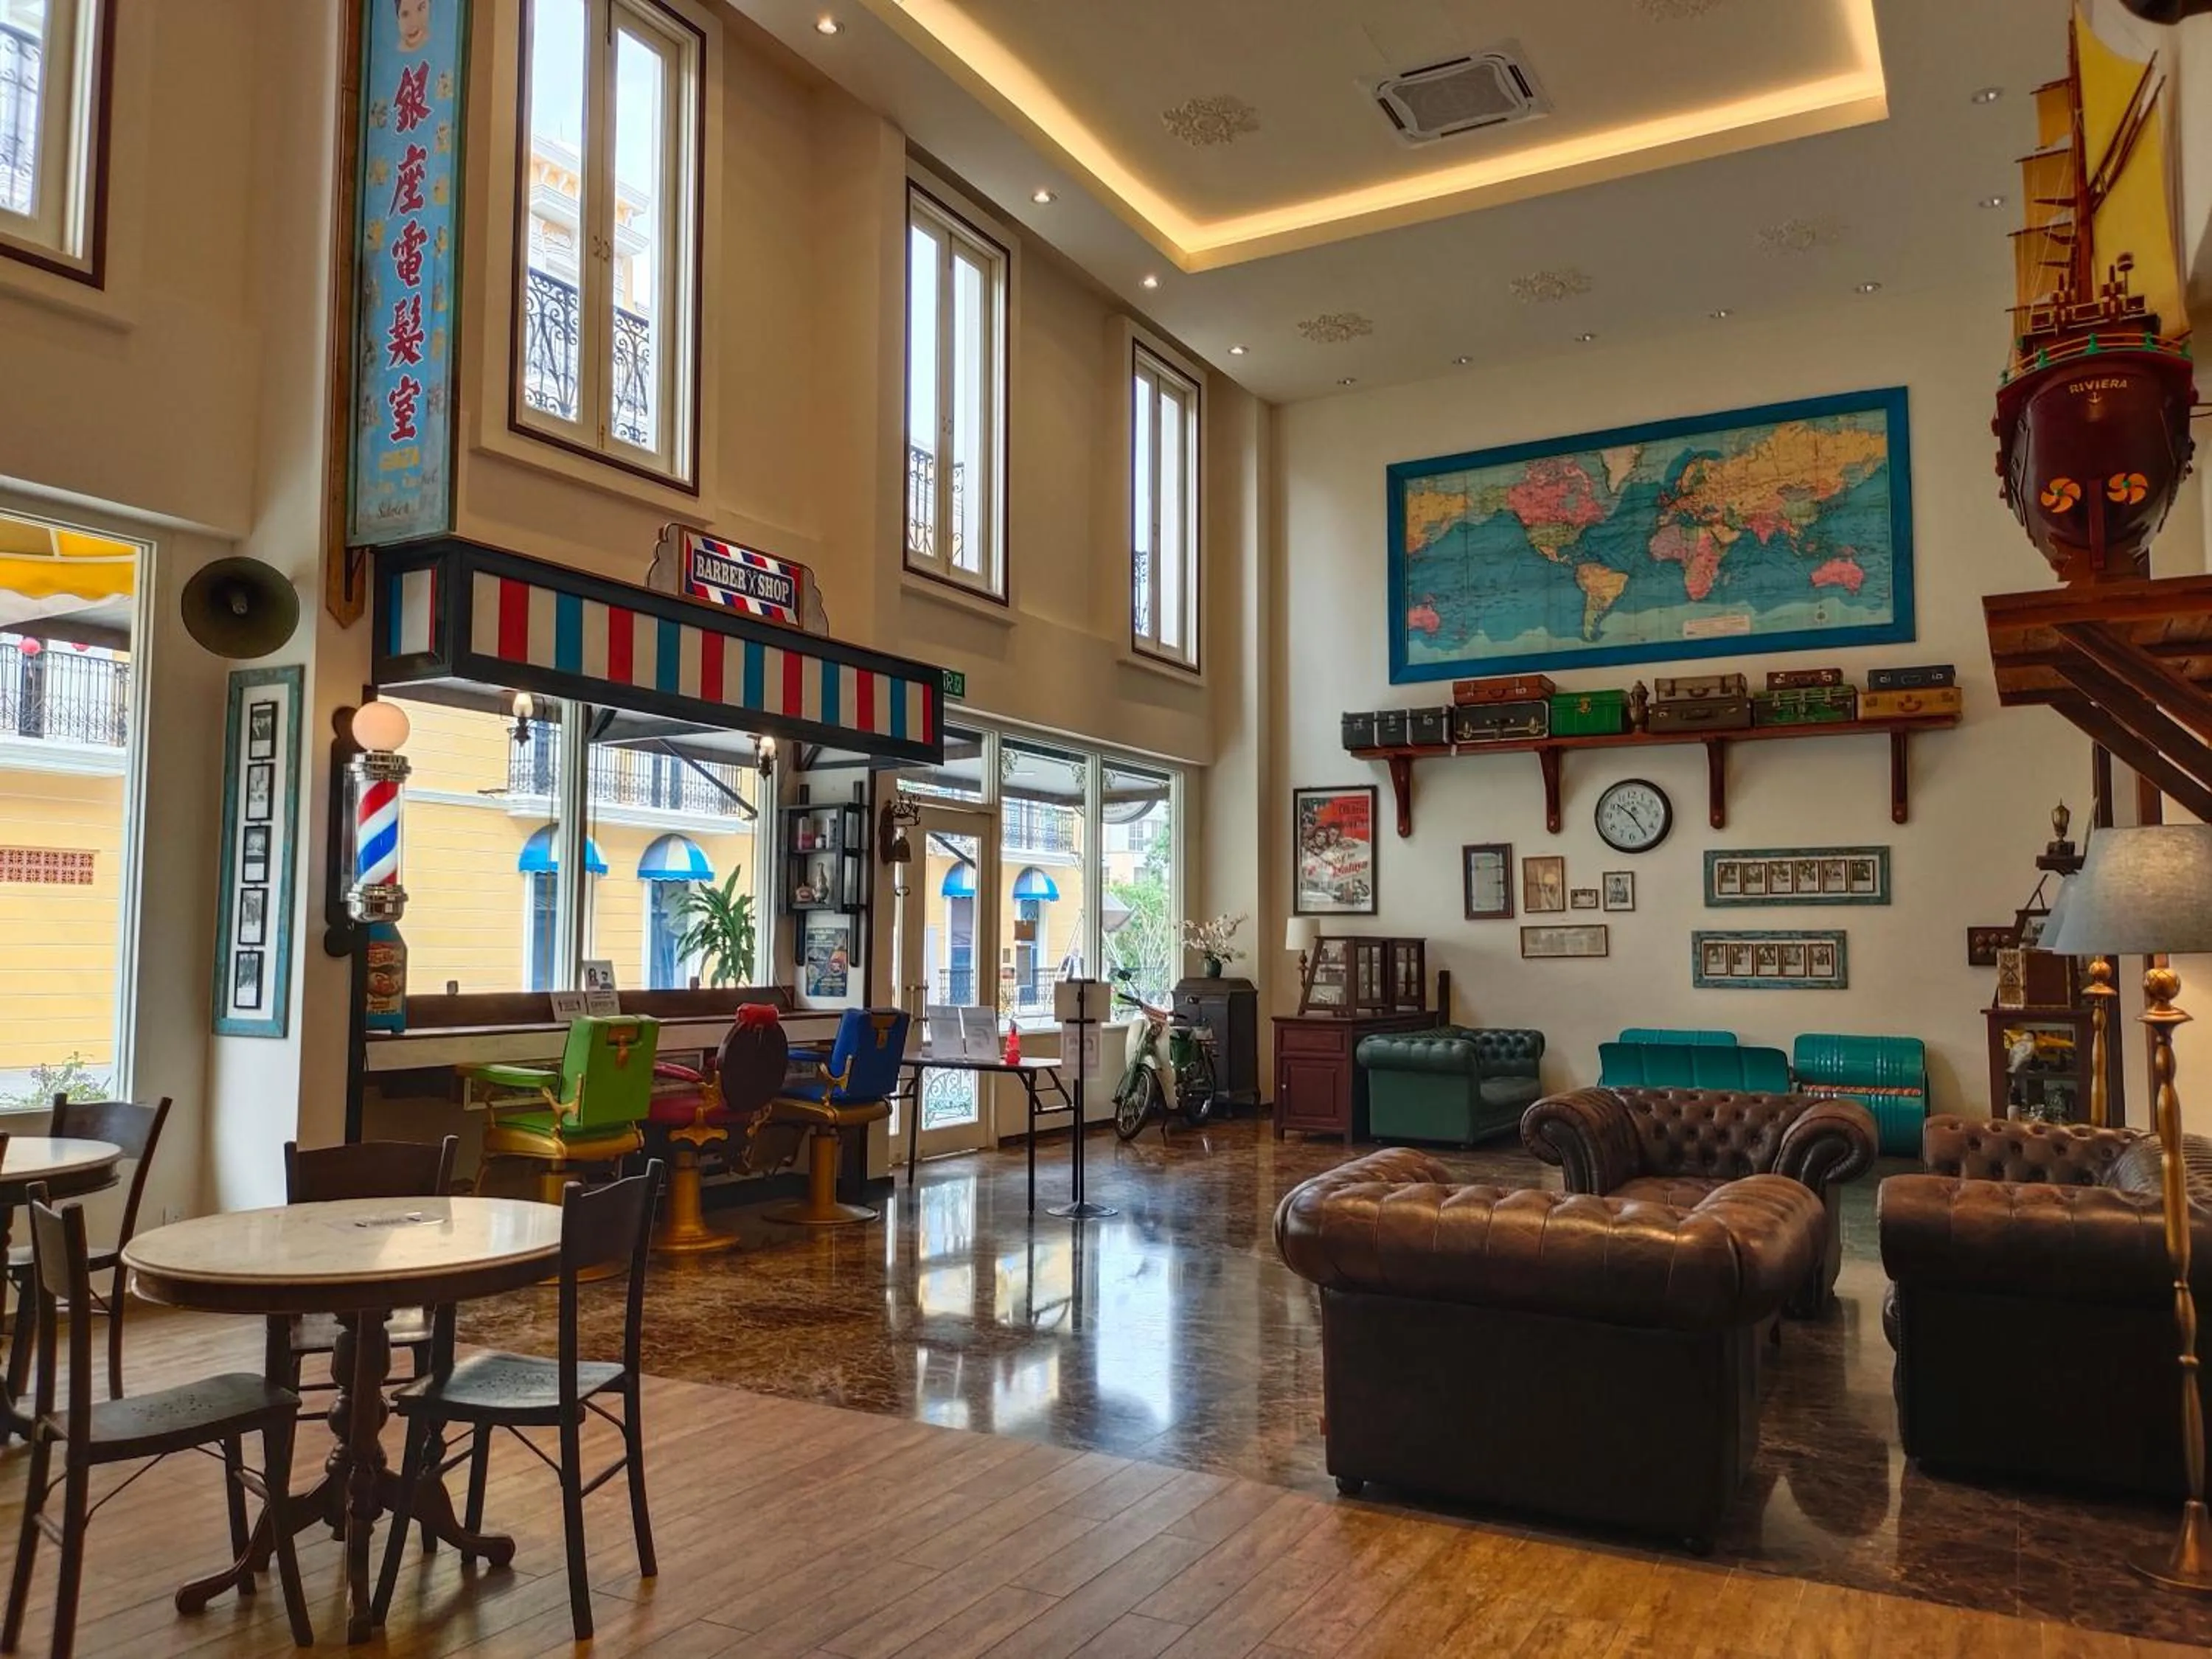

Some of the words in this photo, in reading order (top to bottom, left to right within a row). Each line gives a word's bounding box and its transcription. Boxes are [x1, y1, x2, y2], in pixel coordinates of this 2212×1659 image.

[387, 59, 434, 442] 銀座電髮室
[2070, 379, 2128, 394] RIVIERA
[696, 555, 745, 591] BARBER
[758, 575, 789, 602] SHOP
